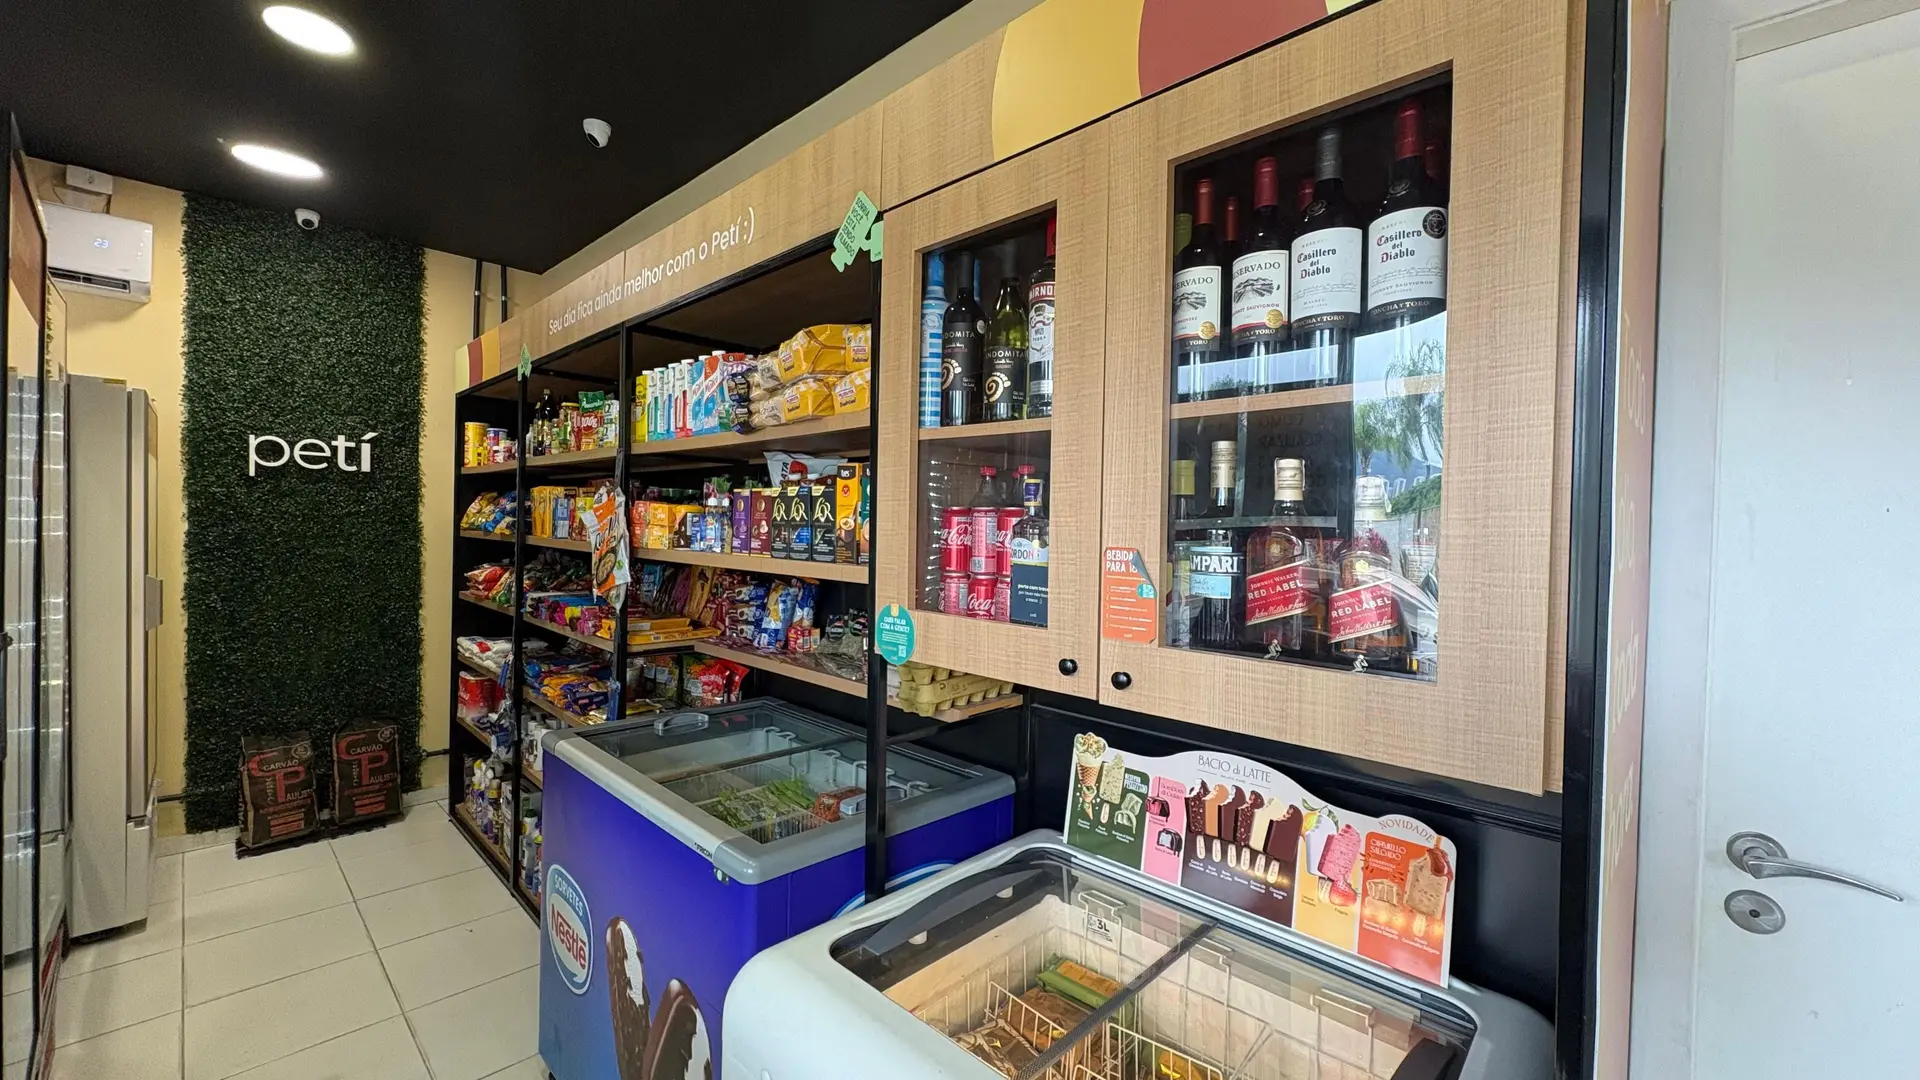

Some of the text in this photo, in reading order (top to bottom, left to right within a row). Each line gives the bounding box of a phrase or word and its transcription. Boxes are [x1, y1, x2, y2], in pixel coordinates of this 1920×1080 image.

[94, 238, 108, 248] 23
[1377, 229, 1422, 246] Casillero
[1392, 241, 1402, 250] del
[1297, 248, 1337, 263] Casillero
[1381, 248, 1415, 263] Diablo
[549, 312, 563, 336] Seu
[563, 306, 576, 328] dia
[577, 300, 593, 321] fica
[594, 284, 622, 311] ainda
[623, 262, 664, 298] melhor
[666, 249, 695, 277] com
[698, 241, 708, 260] o
[711, 214, 742, 256] Petí
[1300, 265, 1331, 279] Diablo
[1405, 300, 1430, 308] TORO
[1623, 307, 1646, 438] Todo
[248, 431, 378, 478] petí
[1106, 561, 1126, 573] PARA
[1190, 555, 1239, 573] MPARI
[1247, 580, 1304, 600] RED LABEL
[1250, 579, 1273, 591] JOHNNIE
[1331, 597, 1391, 618] RED LABEL
[350, 743, 383, 755] CARVÃO
[263, 759, 299, 772] CARVÃO
[1198, 755, 1231, 772] BACIO
[1233, 764, 1241, 775] di
[1243, 766, 1272, 783] LATTE
[1378, 818, 1435, 843] NOVIDADE
[555, 874, 584, 916] SORVETES
